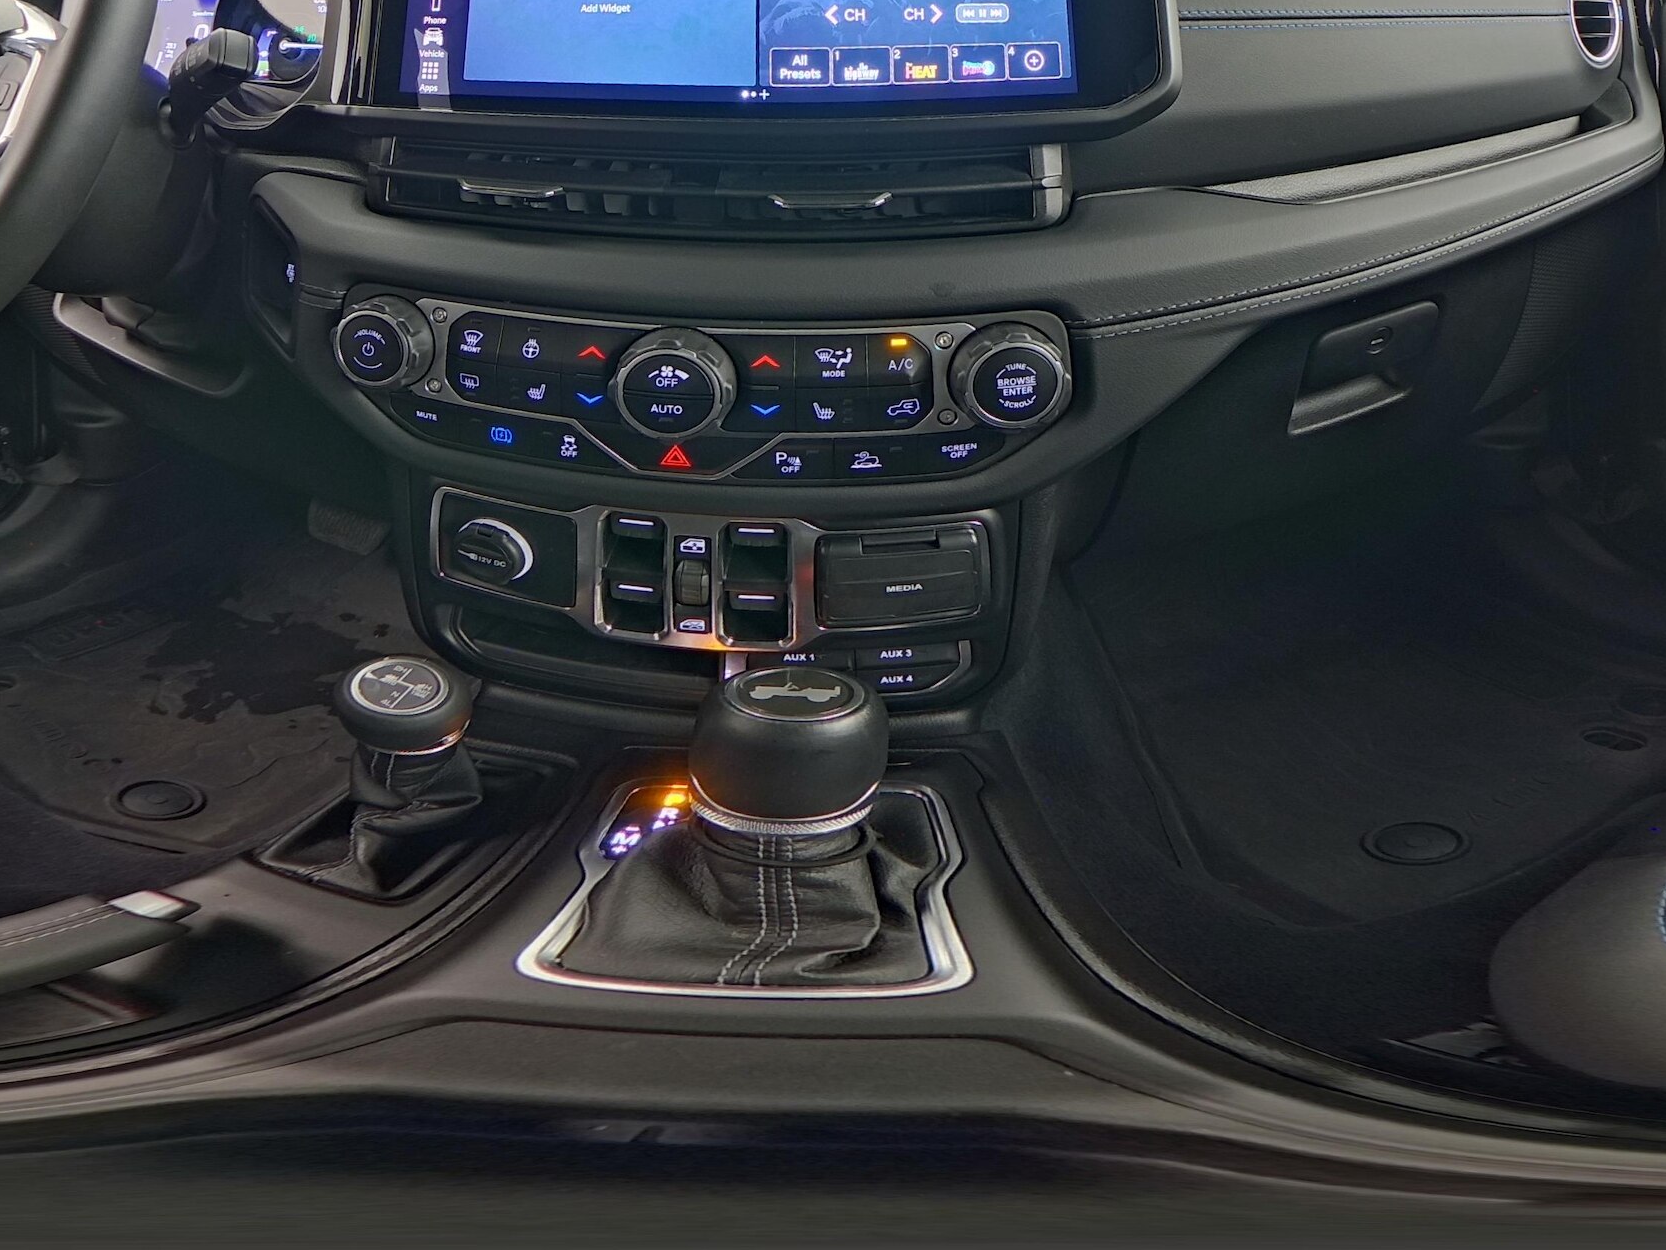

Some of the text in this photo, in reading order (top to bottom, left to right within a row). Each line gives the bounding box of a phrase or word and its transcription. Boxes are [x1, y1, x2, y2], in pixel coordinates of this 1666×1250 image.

[580, 3, 631, 15] Add Widget
[904, 8, 925, 21] CH
[423, 16, 447, 25] Phone
[844, 8, 866, 22] CH
[194, 23, 209, 41] 0
[419, 50, 445, 58] Vehicle
[894, 49, 901, 59] 2
[951, 47, 959, 57] 3
[1008, 47, 1015, 56] 4
[792, 55, 808, 66] All
[779, 67, 822, 81] Presets
[844, 66, 879, 81] highway
[905, 65, 938, 79] HEAT
[418, 84, 438, 93] Apps
[357, 328, 382, 341] VOLUME
[460, 344, 482, 354] FRONT
[888, 357, 914, 372] A/C
[1005, 363, 1027, 372] TUNE
[822, 370, 846, 378] MODE
[655, 376, 679, 388] OFF
[997, 376, 1036, 387] BROWSE
[1002, 386, 1034, 397] ENTER
[650, 404, 683, 415] AUTO
[1003, 398, 1032, 410] SCROLL
[416, 410, 438, 421] MUTE
[560, 449, 578, 458] OFF
[941, 443, 978, 455] SCREEN
[950, 450, 968, 459] OFF
[781, 465, 800, 474] OFF
[478, 556, 507, 568] 12V DC
[885, 582, 923, 594] MEDIA
[783, 653, 807, 662] AUX
[880, 650, 913, 659] AUX 3
[880, 675, 914, 685] AUX 4
[658, 807, 679, 819] R
[610, 830, 641, 846] M
